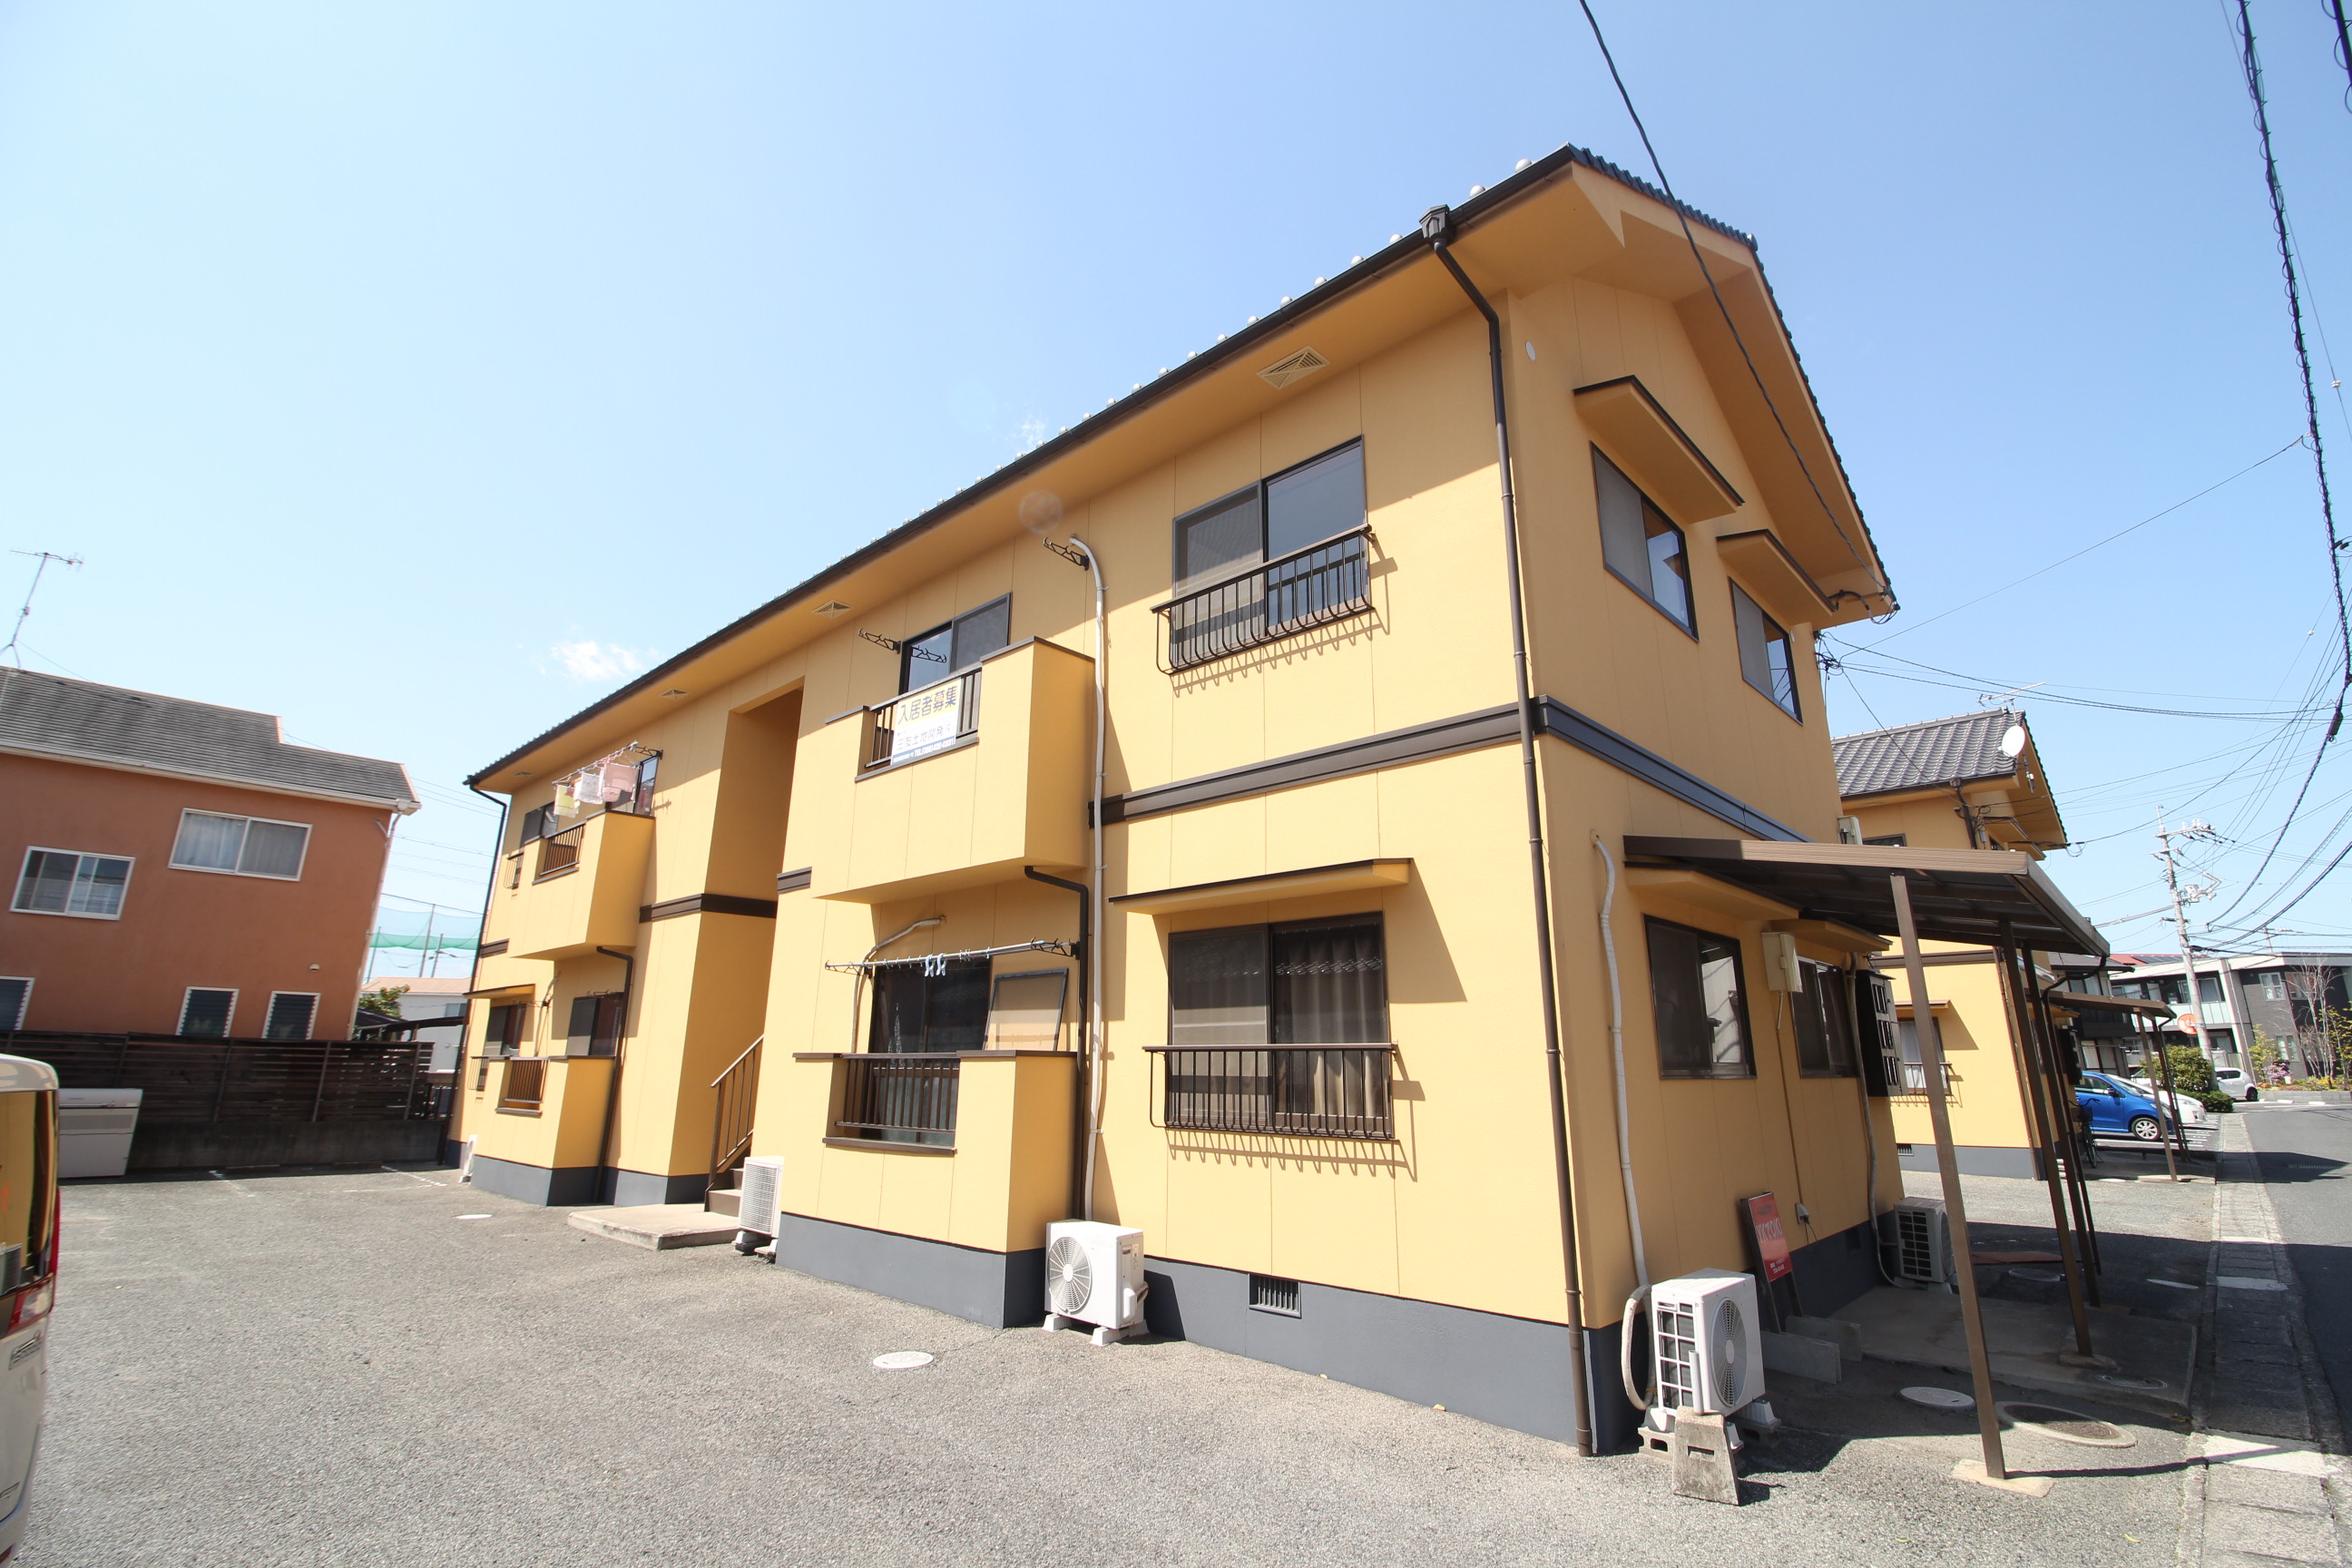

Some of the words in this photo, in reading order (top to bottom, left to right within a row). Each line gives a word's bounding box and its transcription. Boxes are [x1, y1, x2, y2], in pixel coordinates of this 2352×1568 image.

[898, 685, 957, 724] 入居者募集
